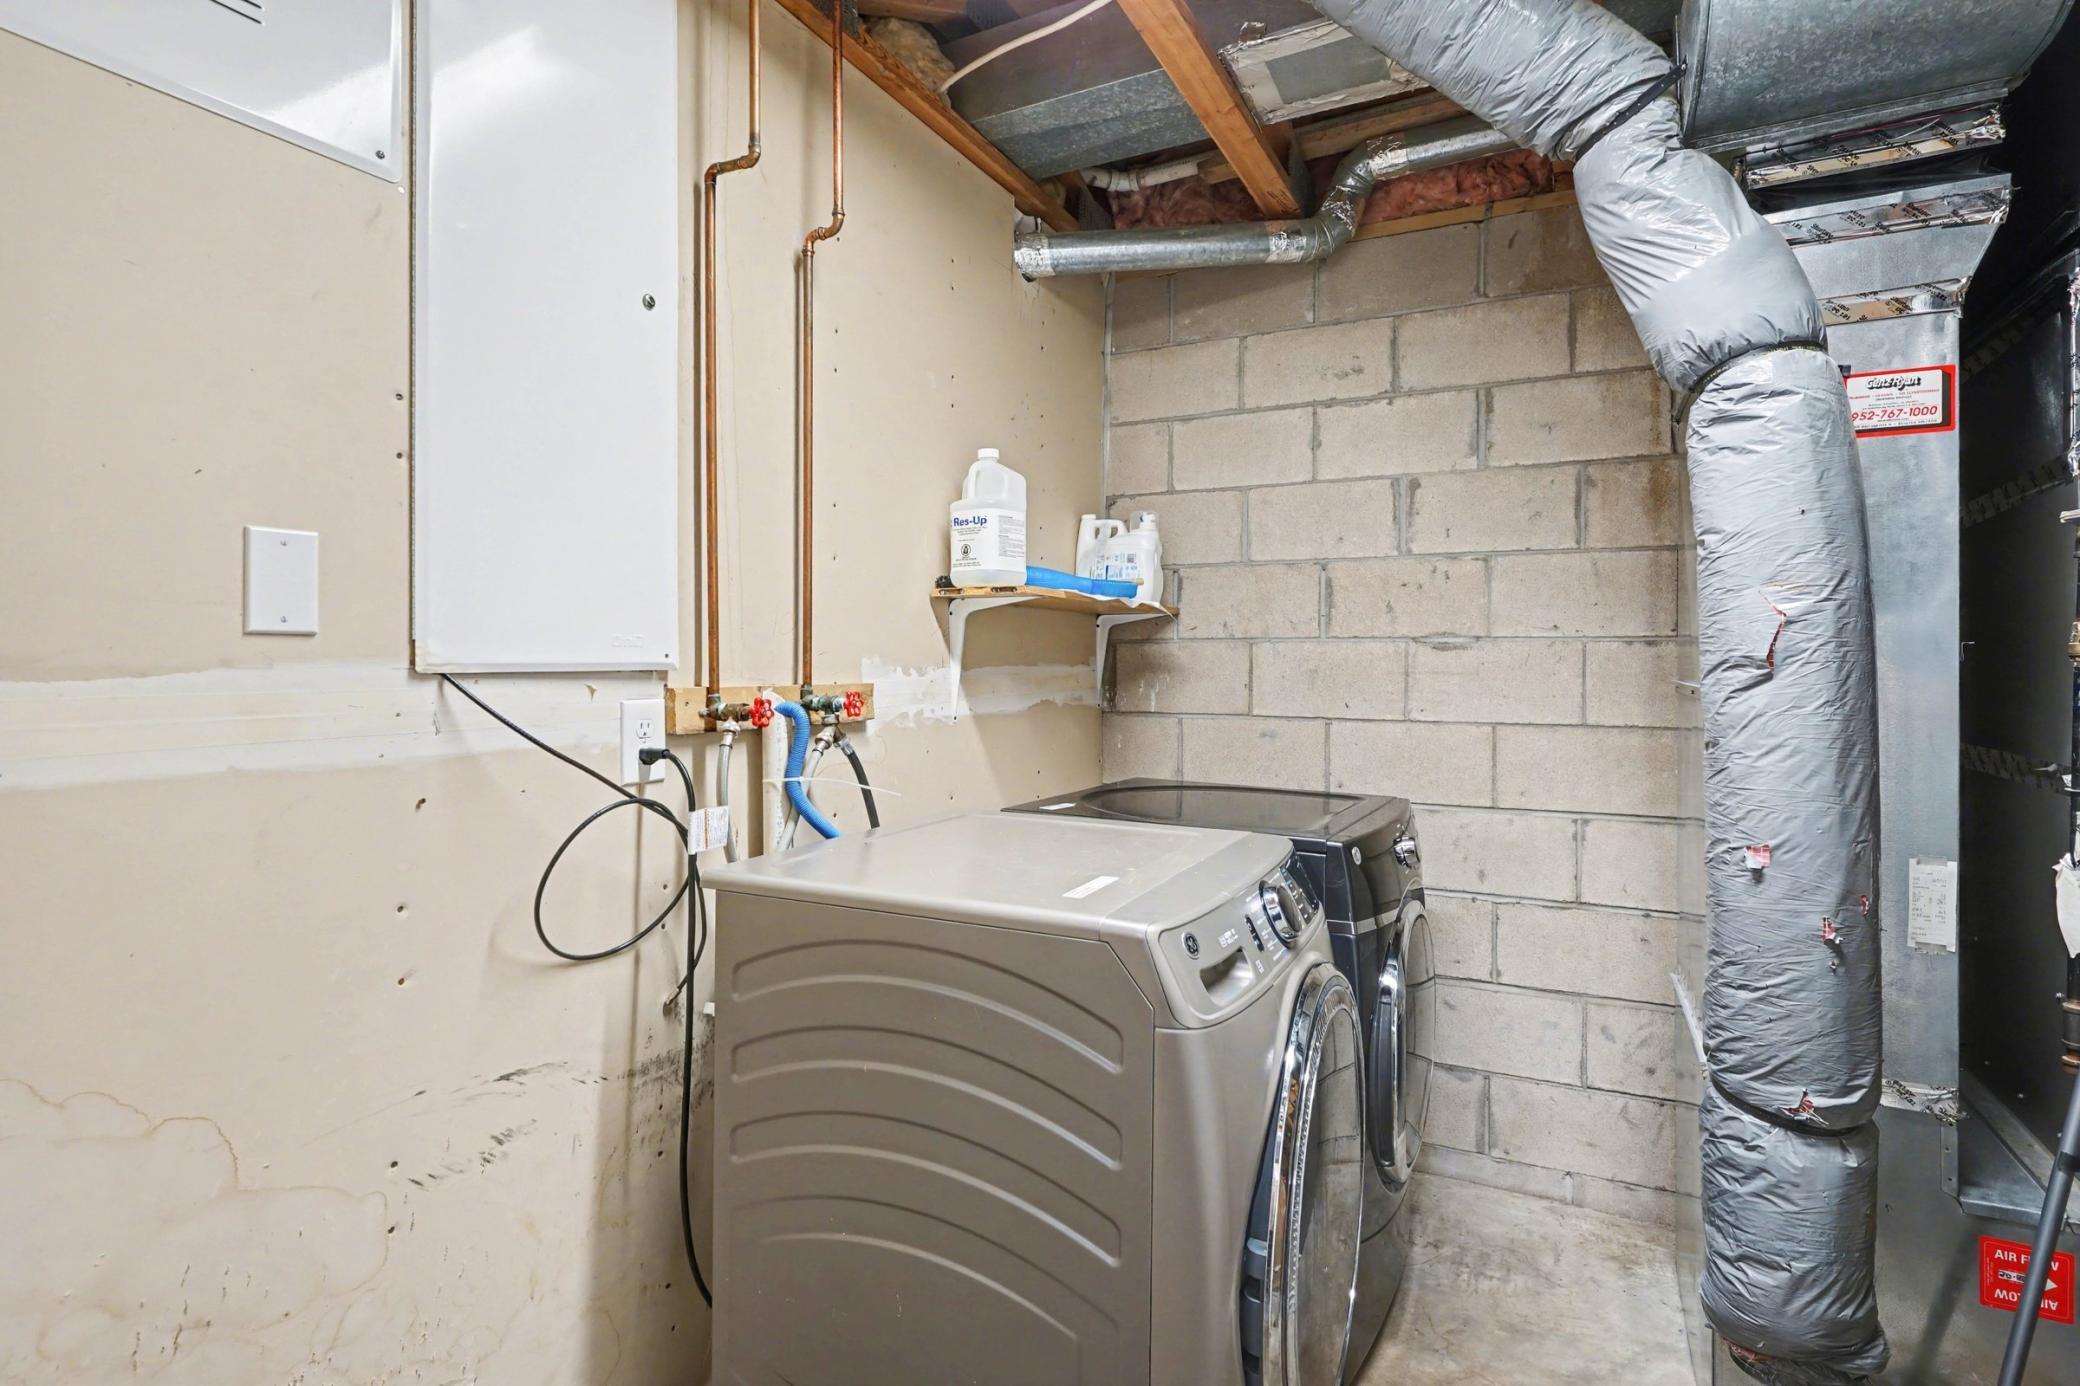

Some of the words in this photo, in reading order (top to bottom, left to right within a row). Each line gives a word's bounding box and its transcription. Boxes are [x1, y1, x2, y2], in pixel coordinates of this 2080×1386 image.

[1851, 405, 1938, 422] 952-767-1000
[953, 516, 988, 527] Res-Up
[1994, 1249, 2017, 1262] AIR
